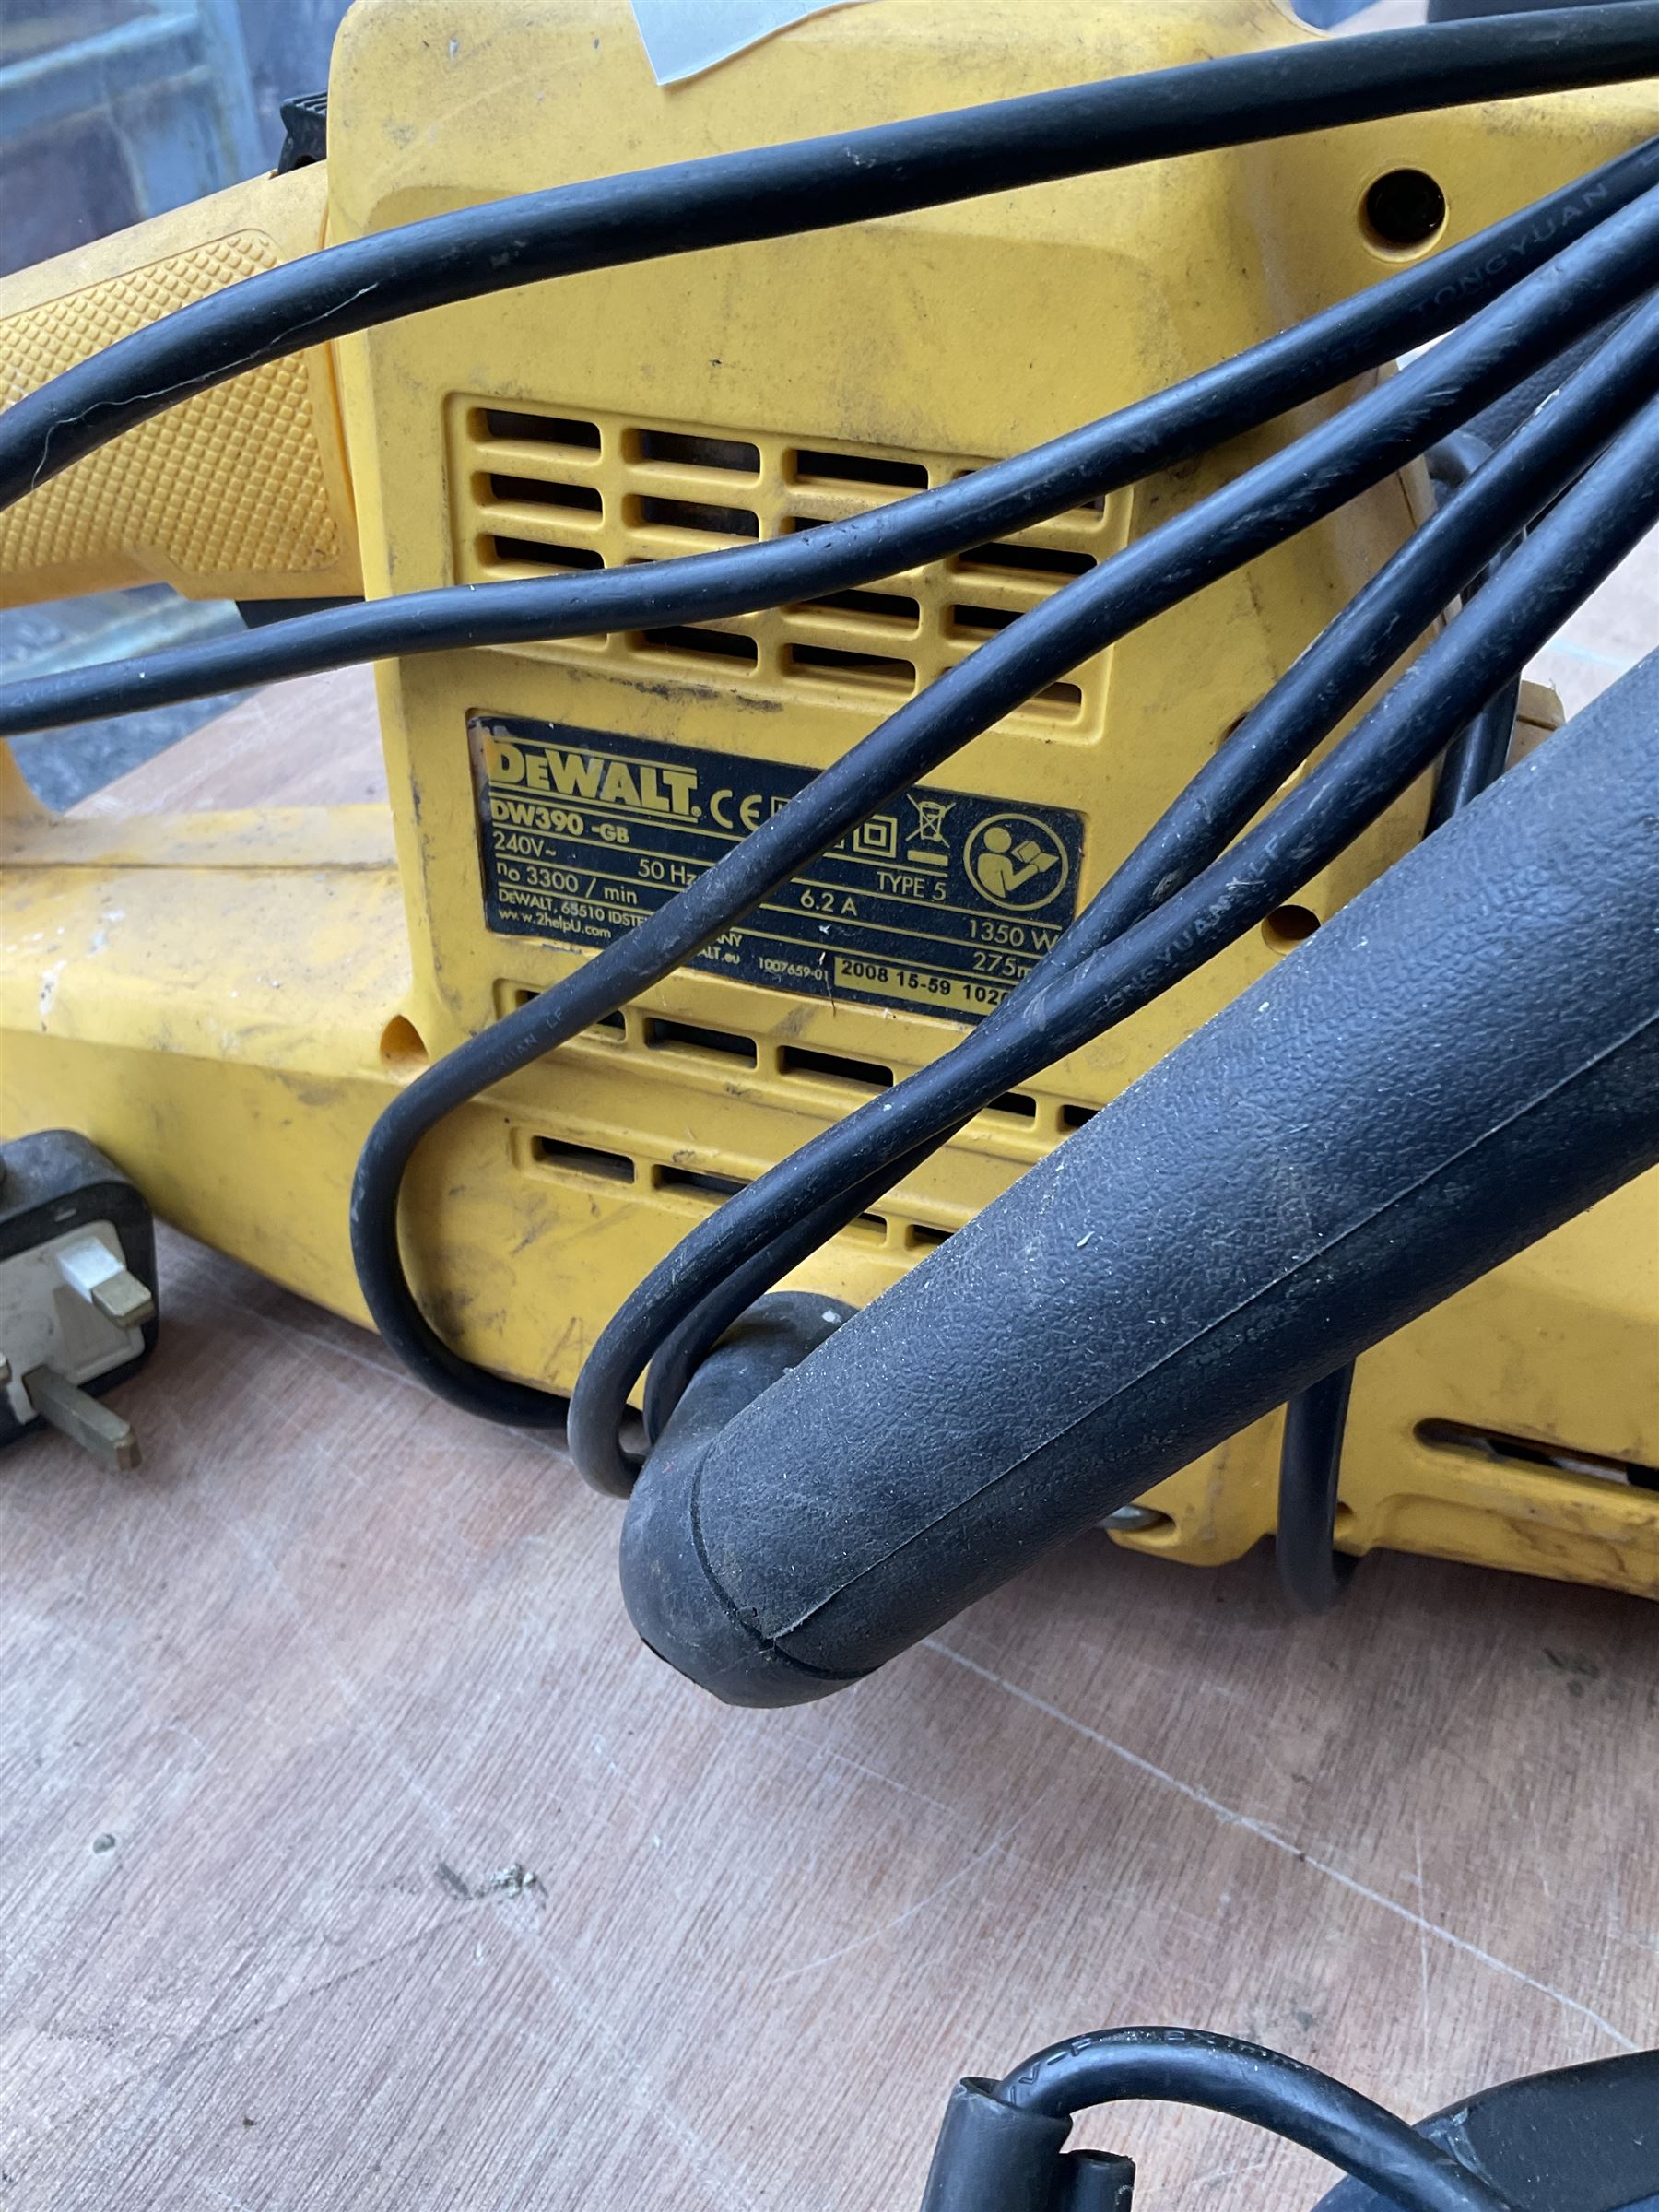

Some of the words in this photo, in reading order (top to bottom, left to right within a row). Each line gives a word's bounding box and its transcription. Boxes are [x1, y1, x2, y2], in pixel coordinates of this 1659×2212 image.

[490, 798, 584, 836] DW390
[638, 858, 665, 880] 50
[526, 866, 579, 893] 3300
[585, 877, 597, 899] /
[604, 884, 638, 905] min
[877, 870, 925, 899] TYPE
[931, 881, 947, 901] 5
[560, 900, 606, 922] 65510
[799, 888, 835, 912] 6.2
[841, 896, 858, 916] A
[969, 918, 1025, 947] 1350
[1030, 929, 1061, 951] W
[841, 959, 888, 982] 2008
[896, 971, 951, 996] 15-59
